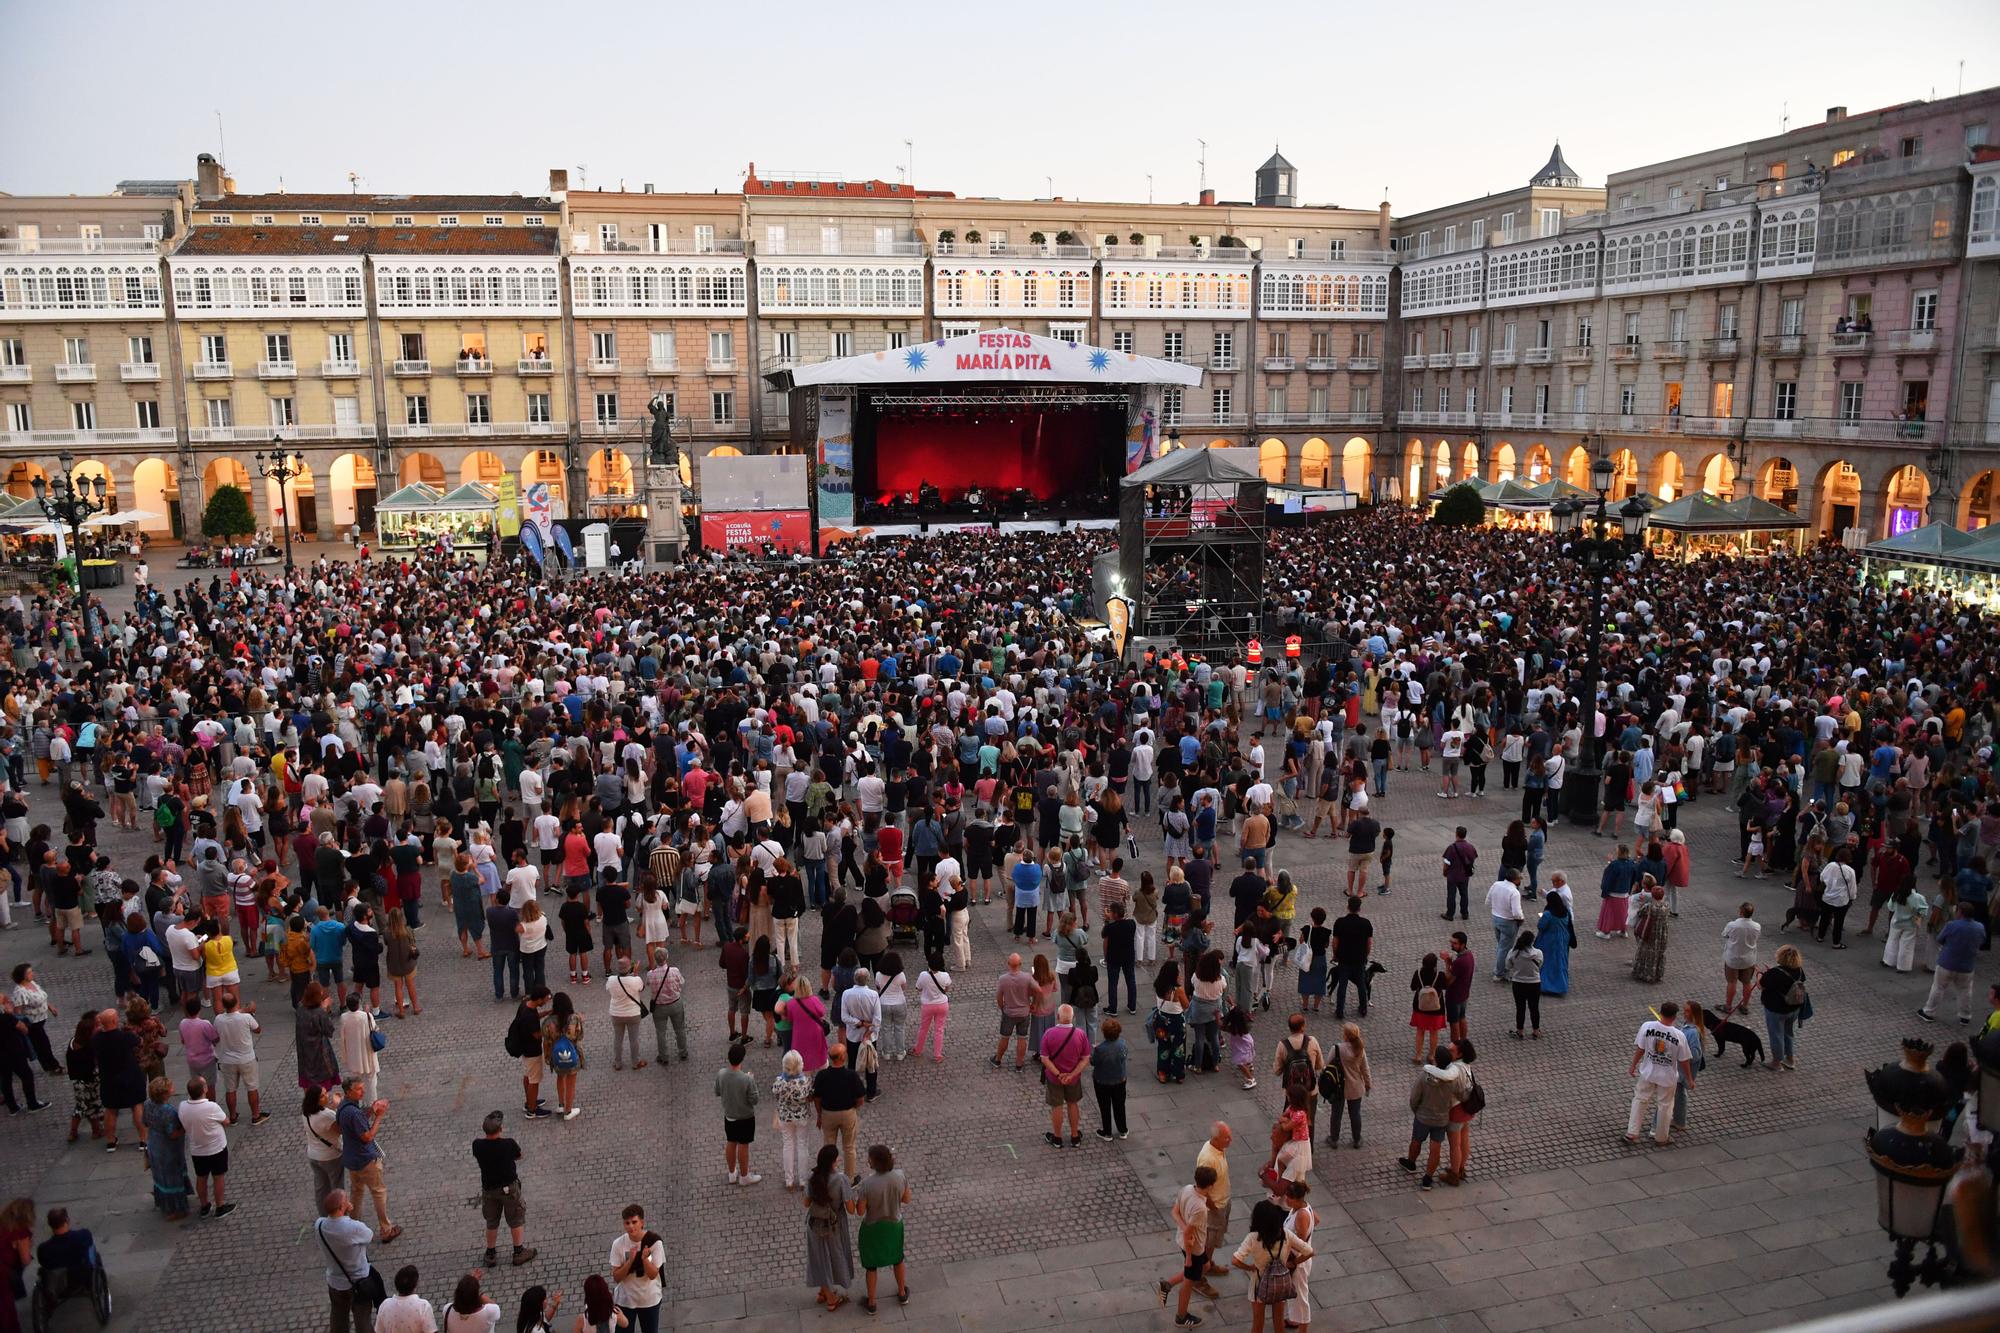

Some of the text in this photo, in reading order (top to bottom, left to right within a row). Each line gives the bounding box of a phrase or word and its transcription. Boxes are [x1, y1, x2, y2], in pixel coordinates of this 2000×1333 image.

[979, 334, 1031, 348] FESTAS
[956, 350, 1051, 370] MARÍA PITA
[726, 534, 754, 543] MARÍA
[1646, 1029, 1680, 1046] Market
